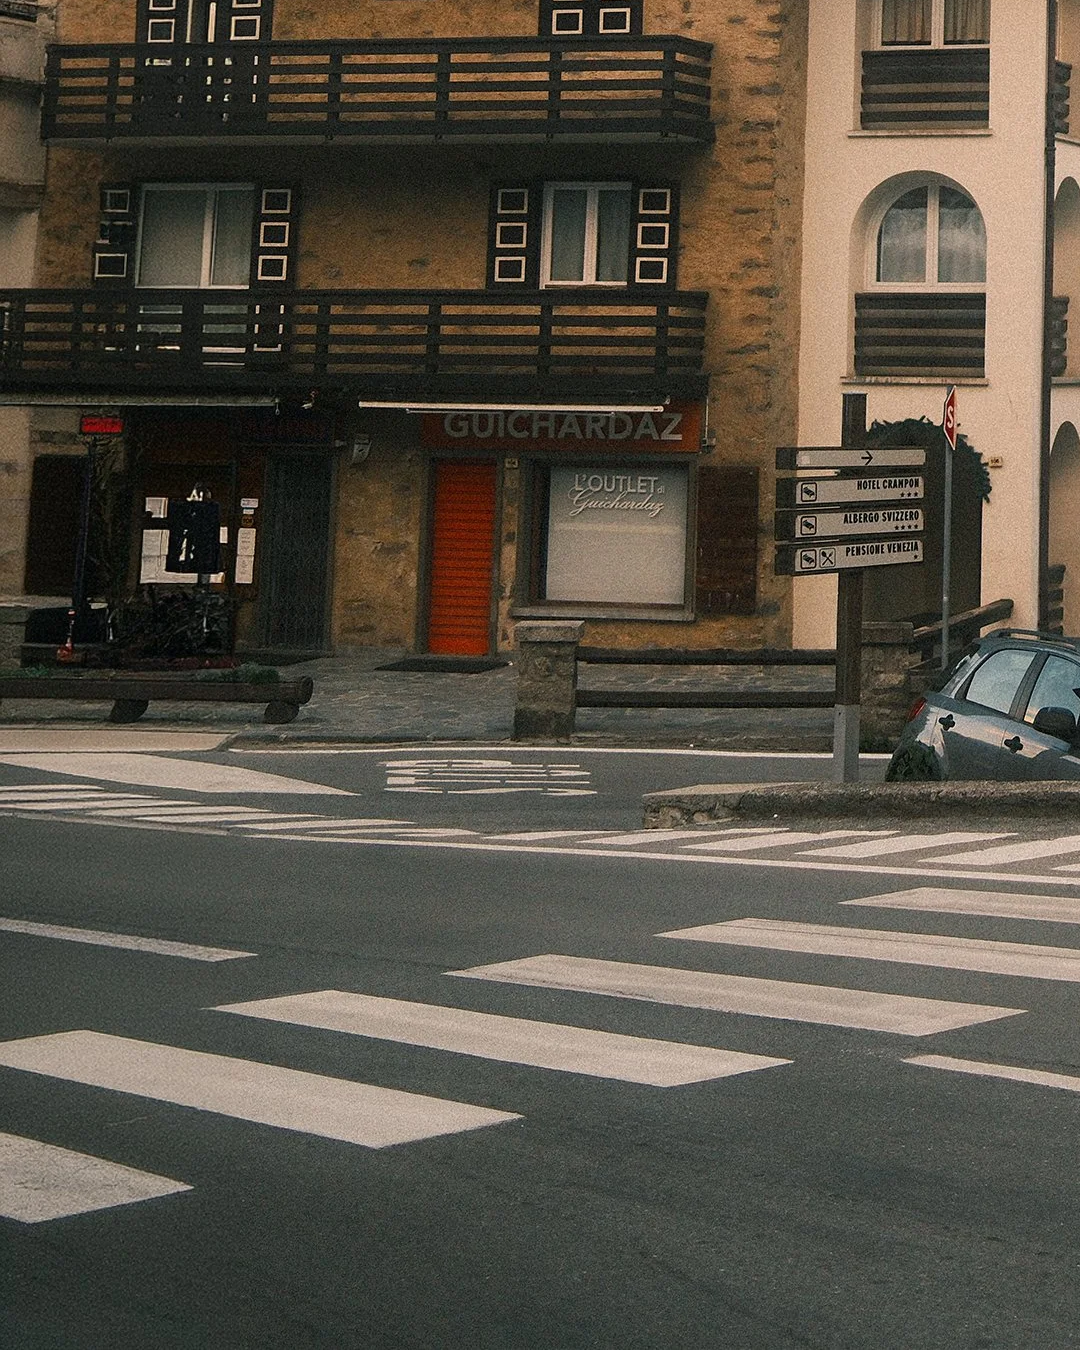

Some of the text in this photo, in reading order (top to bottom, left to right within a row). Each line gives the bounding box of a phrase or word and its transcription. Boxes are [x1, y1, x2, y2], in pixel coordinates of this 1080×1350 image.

[443, 411, 683, 441] GUICHARDAZ
[575, 474, 659, 493] L'OUTLET
[857, 478, 920, 490] HOTEL CRAMPON
[568, 486, 665, 518] Guichardaz
[843, 511, 919, 524] ALBERGO SVIZZERO
[845, 542, 919, 557] PENSIONE VENEZIA
